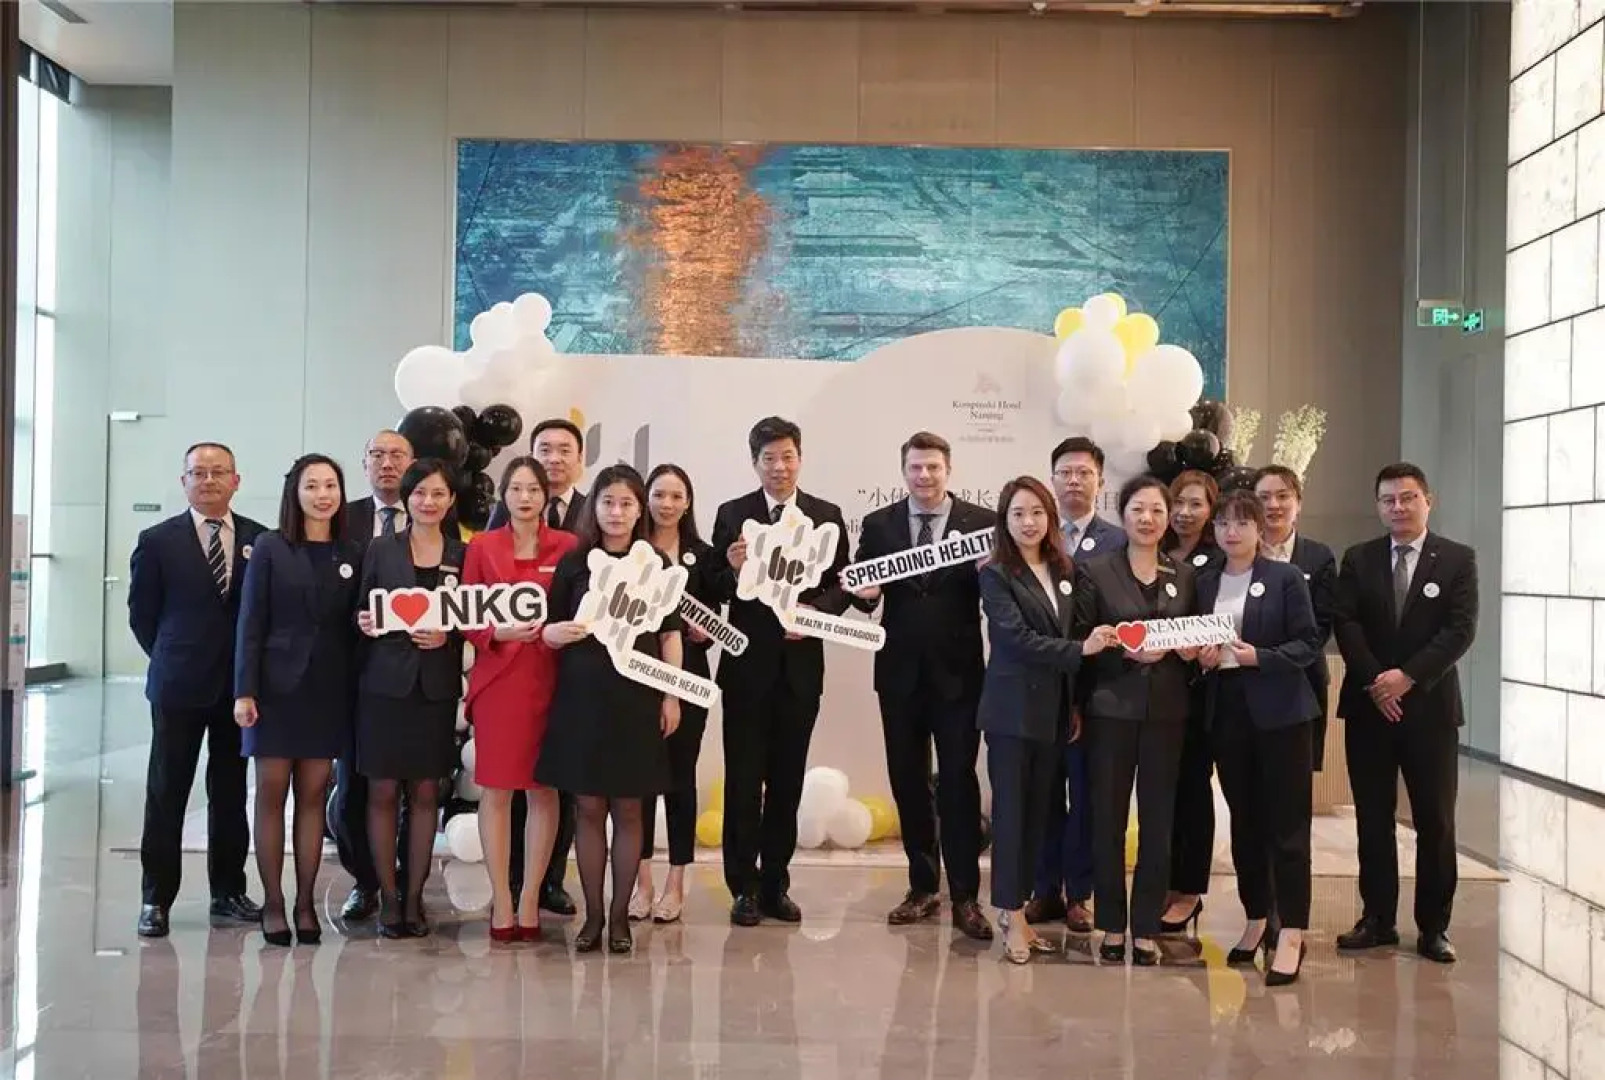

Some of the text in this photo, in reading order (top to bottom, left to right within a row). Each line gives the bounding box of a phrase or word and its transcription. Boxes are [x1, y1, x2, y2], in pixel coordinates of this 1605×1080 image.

[768, 546, 804, 586] be
[846, 550, 935, 587] SPREADING
[375, 587, 542, 629] I NKG
[608, 581, 647, 626] be
[795, 615, 880, 643] HEALTH IS CONTAGIOUS
[1146, 614, 1231, 634] KEMPINSKI
[628, 658, 711, 699] SPREADING HEALTH
